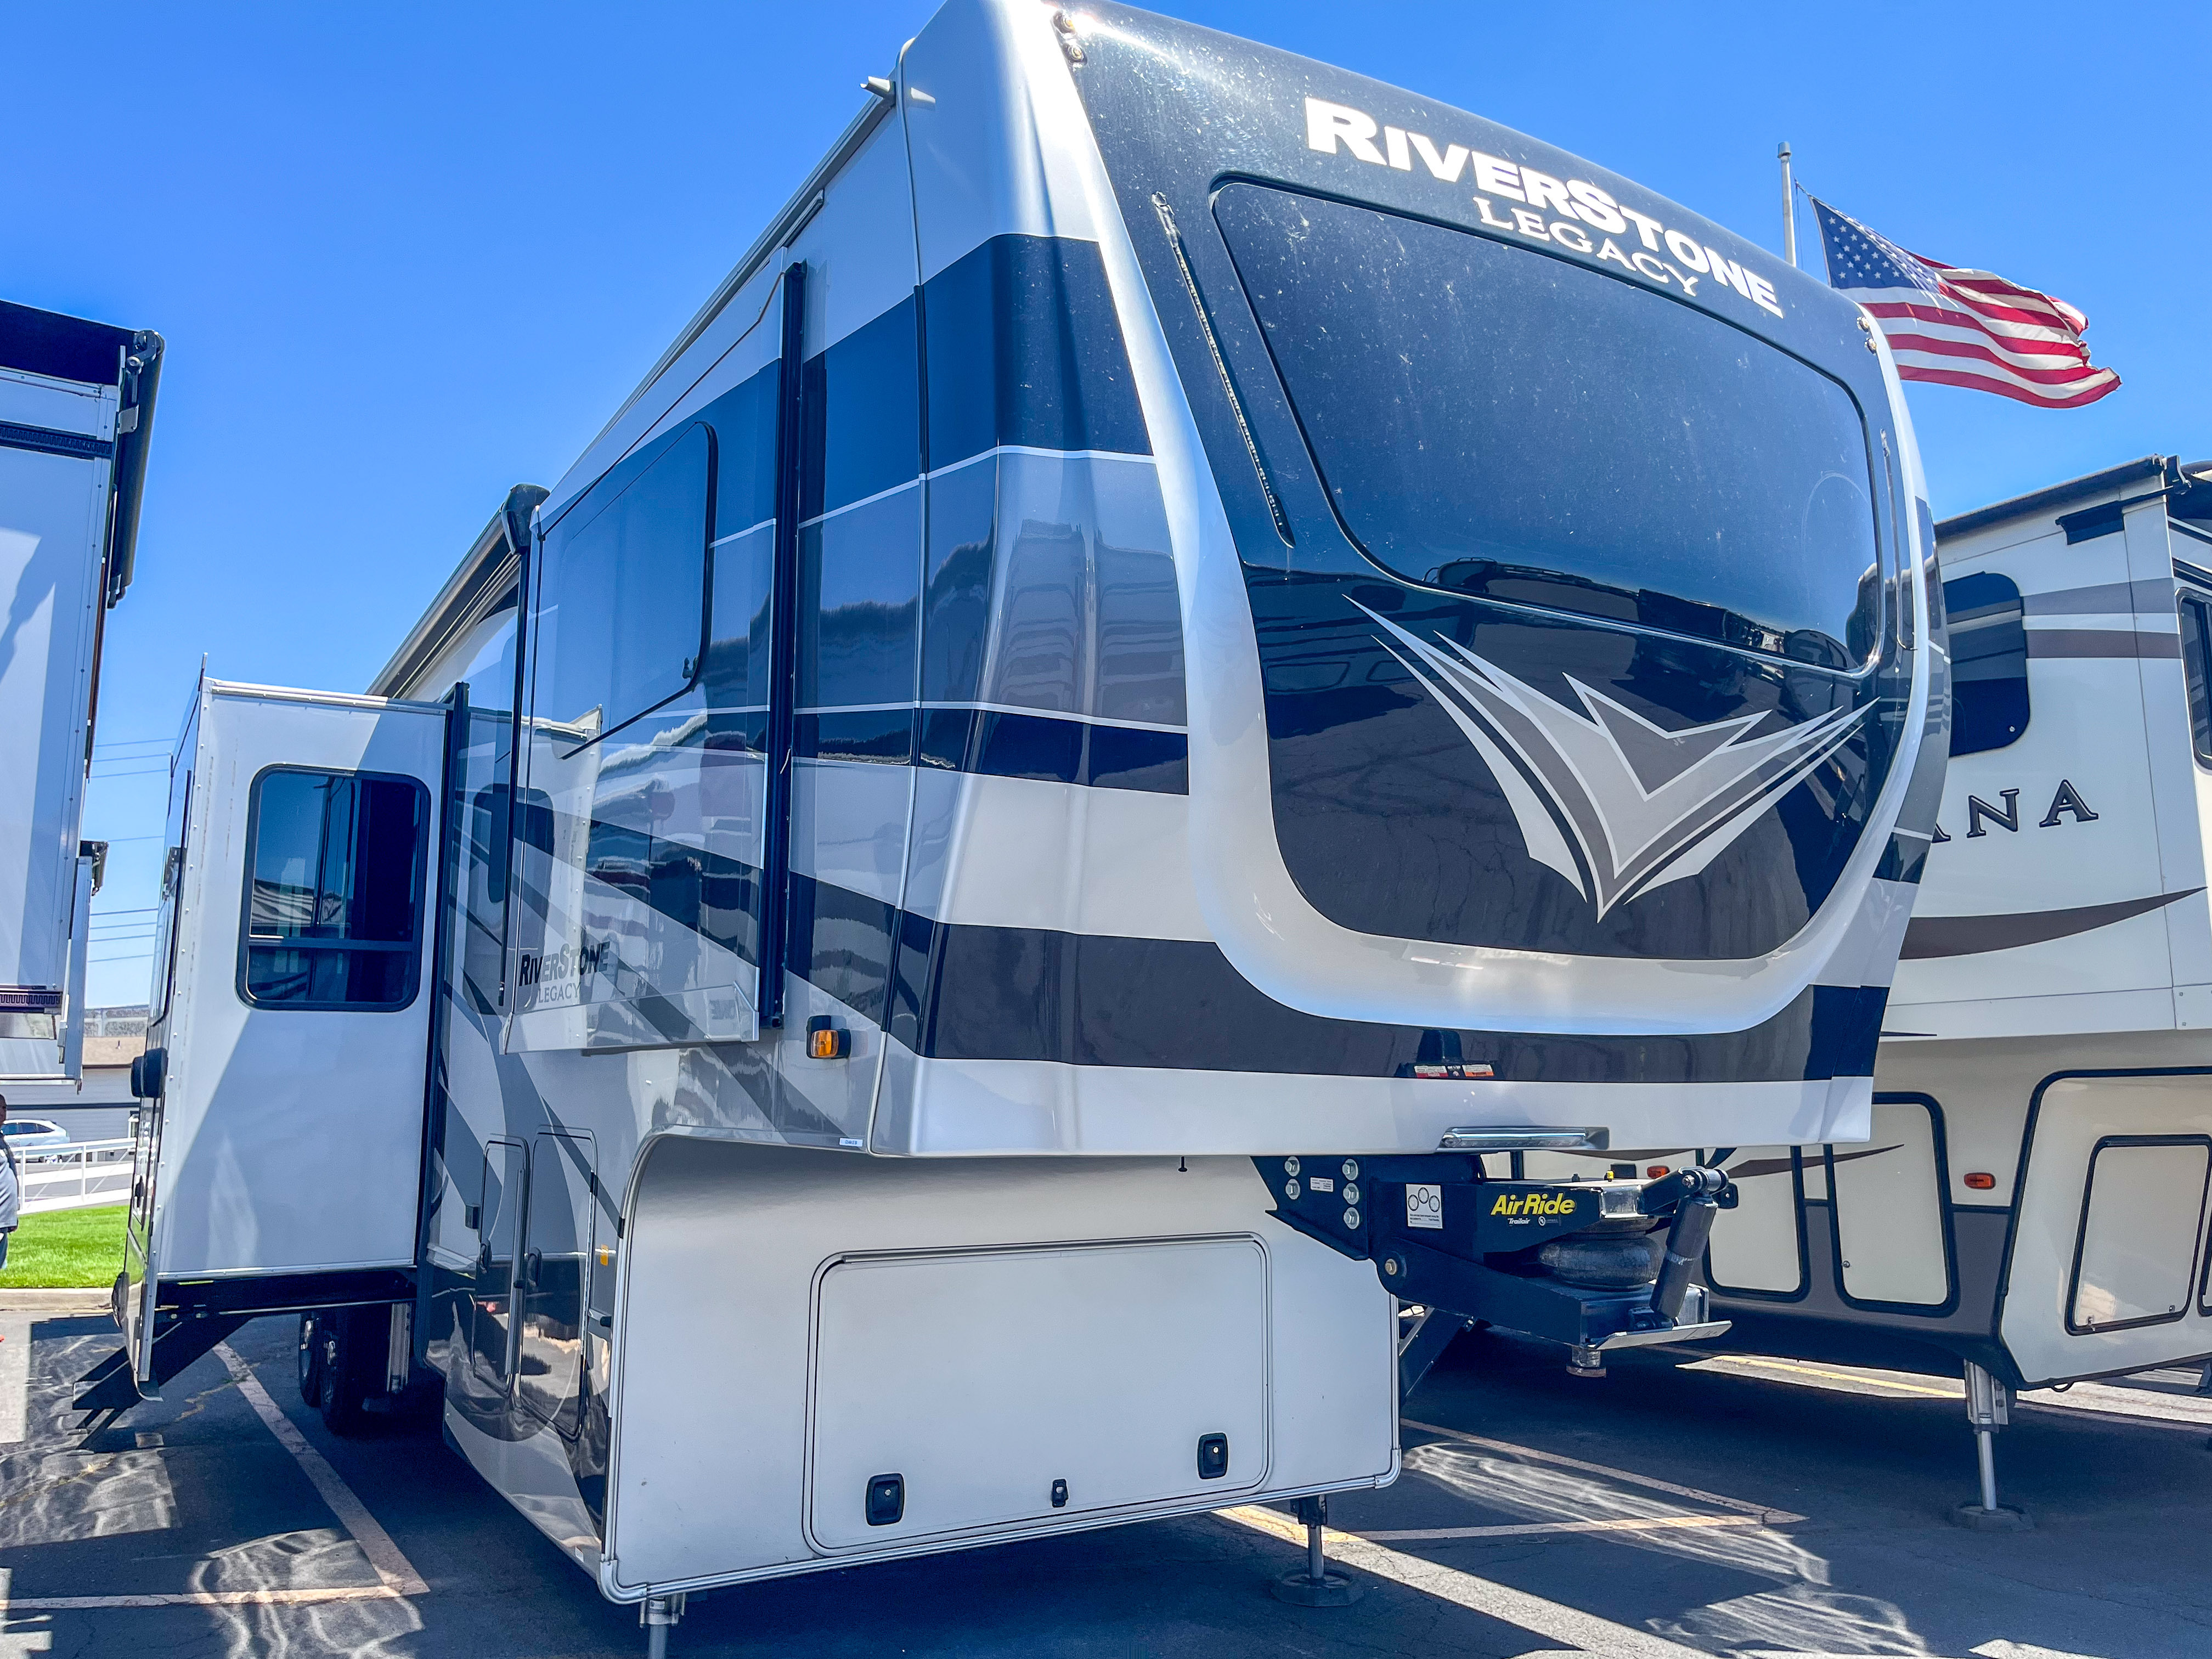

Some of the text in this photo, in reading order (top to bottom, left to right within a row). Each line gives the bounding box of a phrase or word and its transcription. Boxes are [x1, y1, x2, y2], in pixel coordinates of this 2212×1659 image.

[1305, 95, 1784, 319] RIVERSTONE
[1472, 196, 1699, 297] LEGACY
[1931, 779, 2099, 843] NA
[538, 982, 581, 1003] LEGACY
